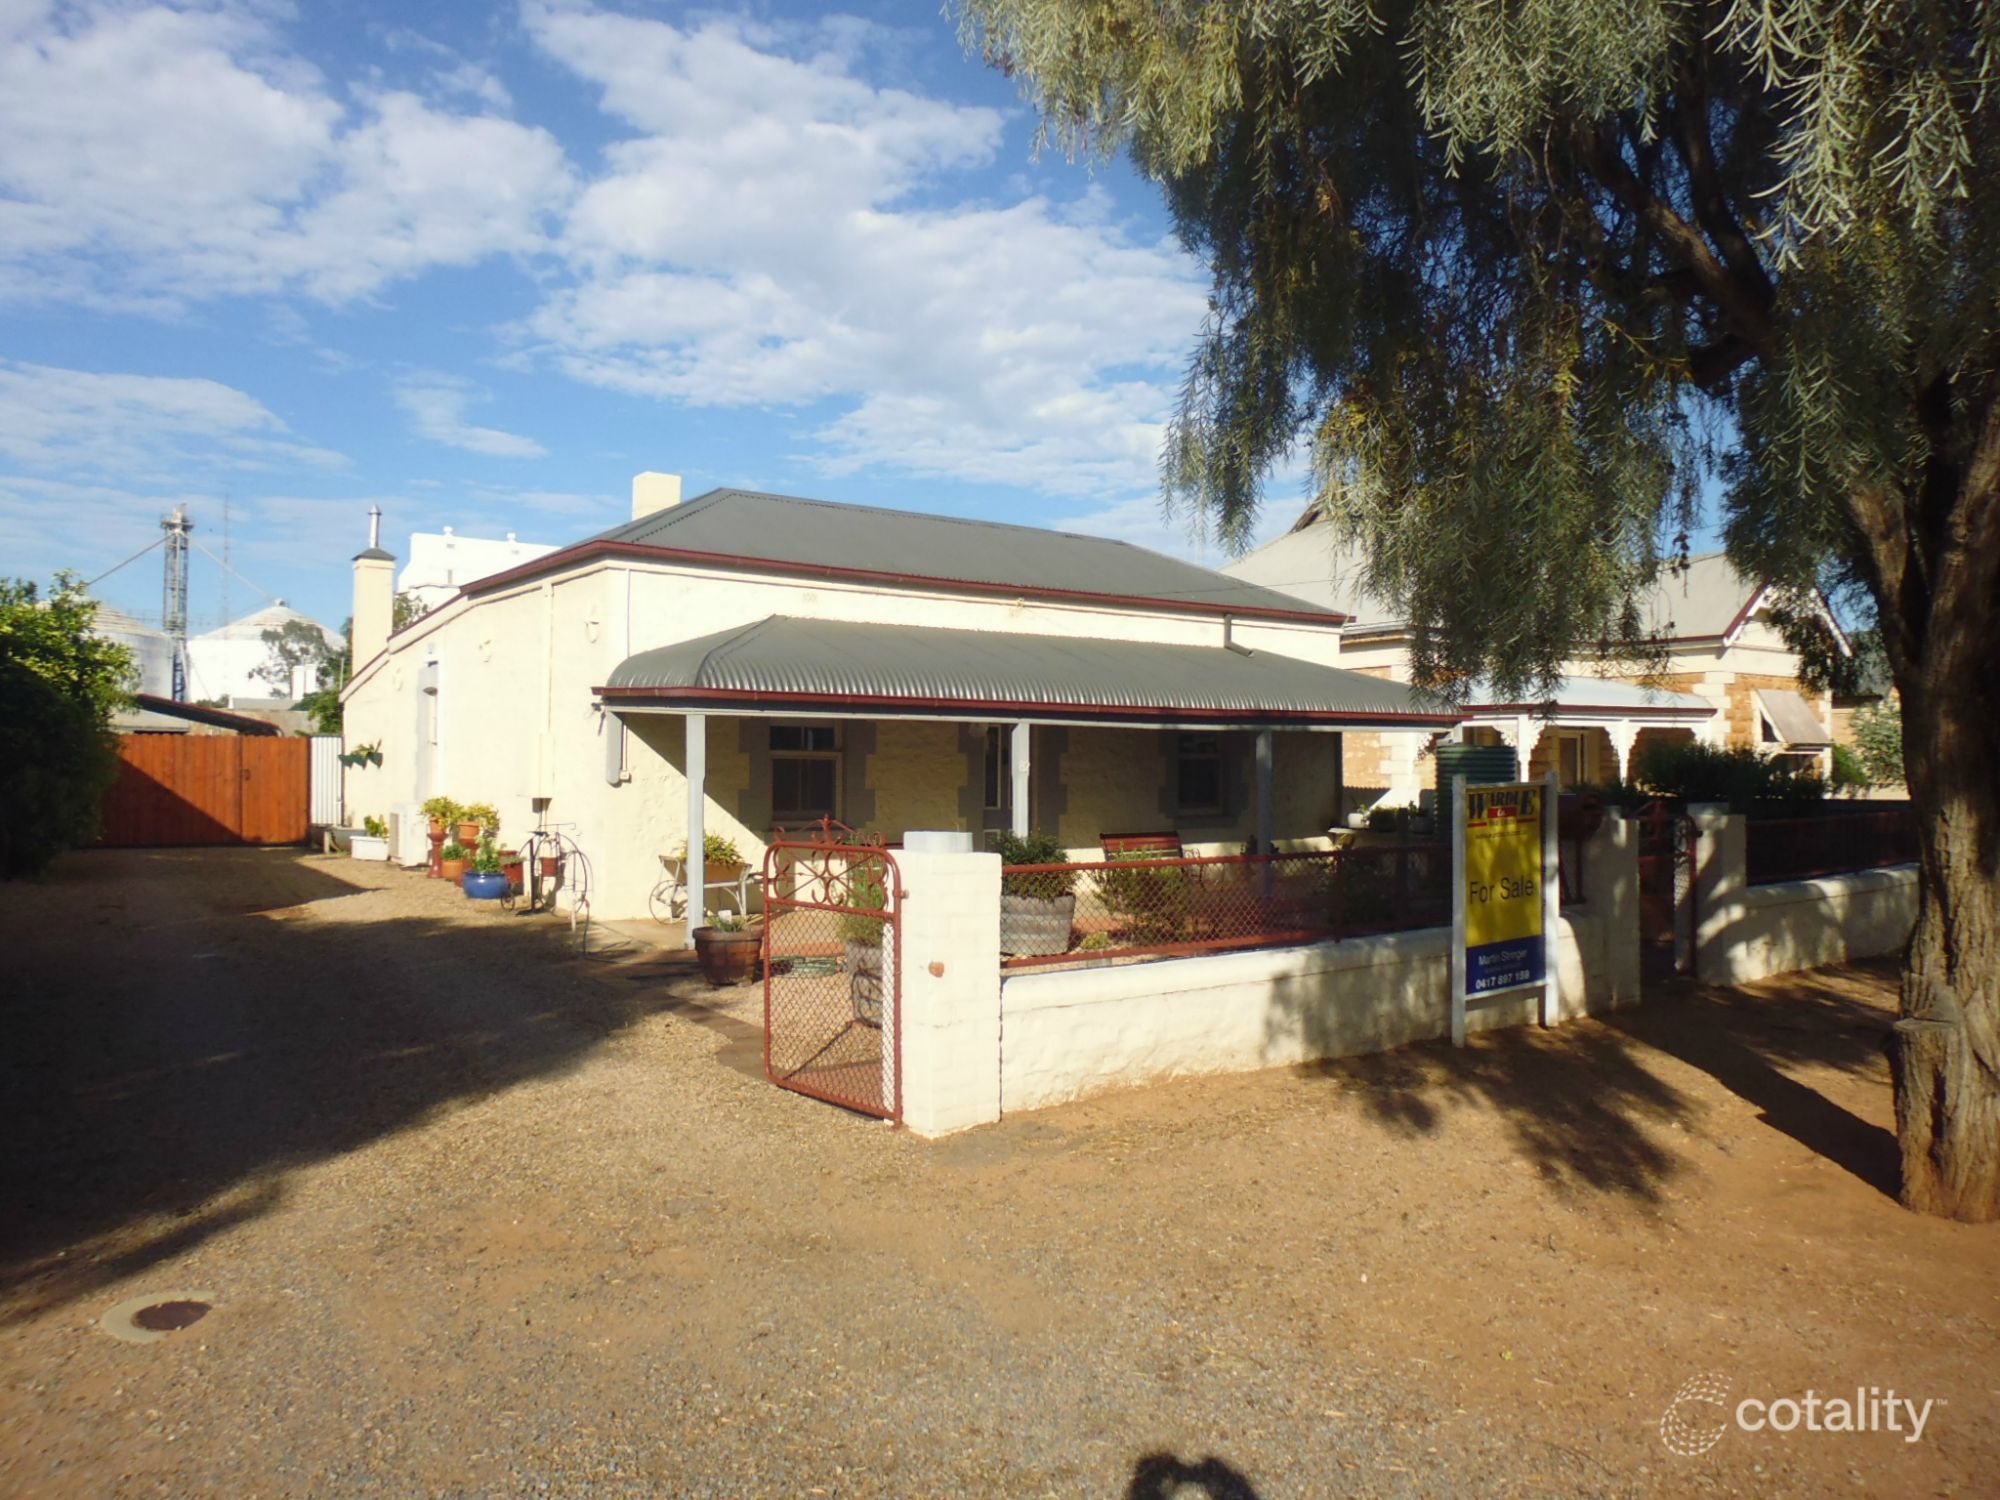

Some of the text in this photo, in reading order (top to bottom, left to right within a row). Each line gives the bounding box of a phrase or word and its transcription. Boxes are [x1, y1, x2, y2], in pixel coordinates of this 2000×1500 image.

[1469, 876, 1534, 904] For Sale
[1475, 976, 1497, 990] 0417
